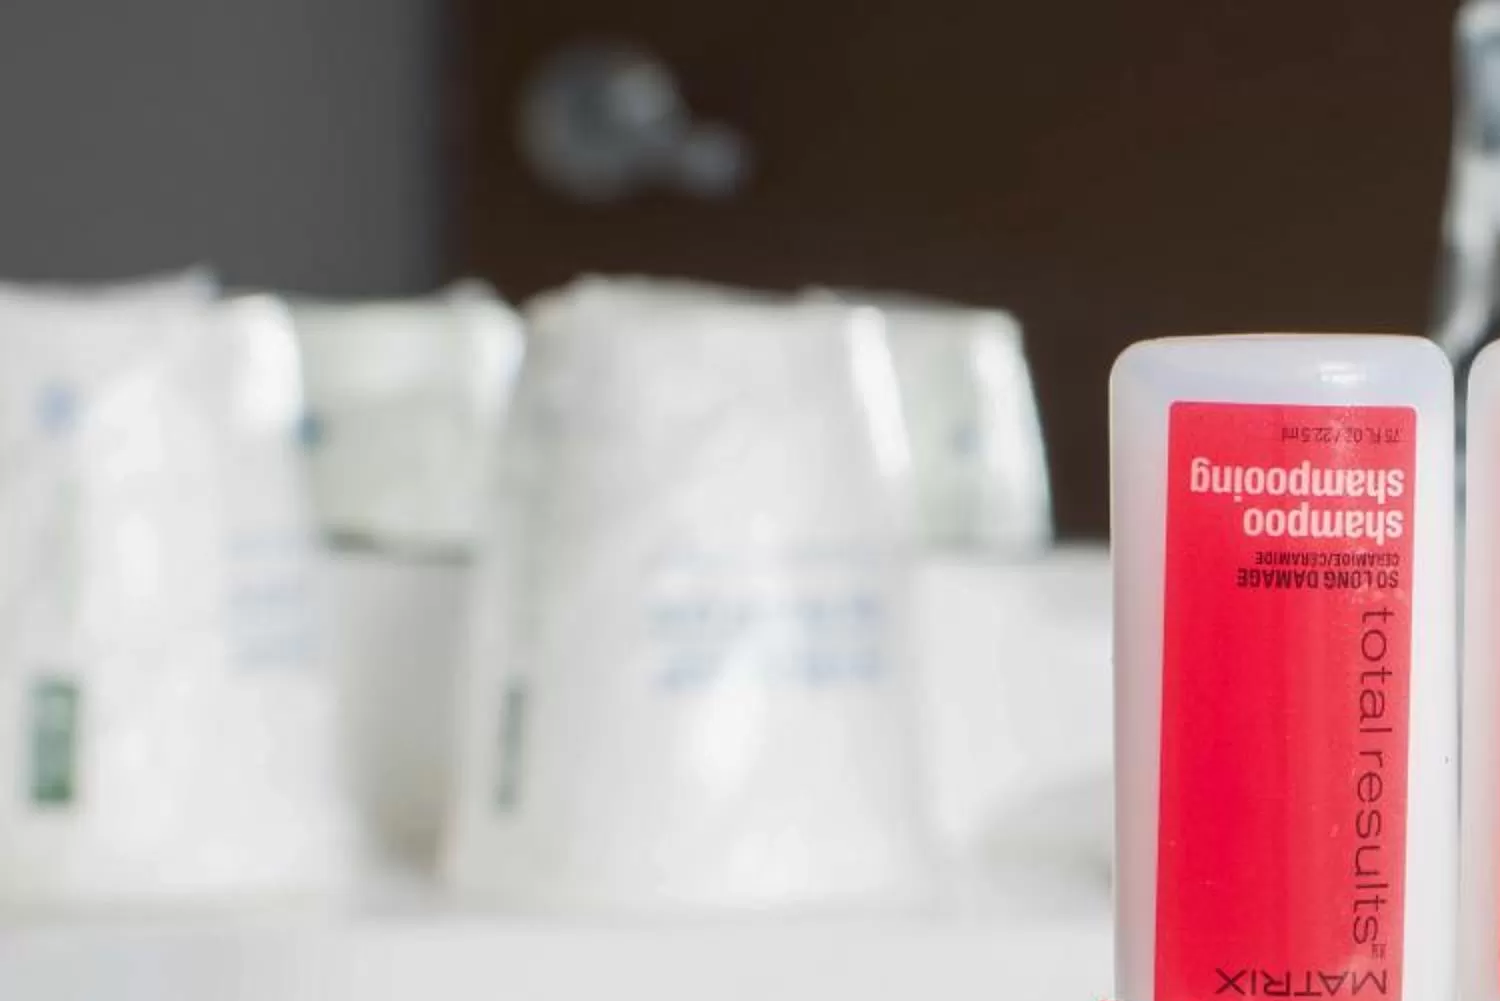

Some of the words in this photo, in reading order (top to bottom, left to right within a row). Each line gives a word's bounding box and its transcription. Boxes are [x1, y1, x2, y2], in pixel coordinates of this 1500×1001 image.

[1282, 428, 1299, 443] ml
[1190, 457, 1405, 504] shampooing
[1243, 501, 1404, 546] shampoo
[1237, 567, 1318, 588] DAMAGE
[1324, 568, 1372, 588] LONG
[1379, 569, 1399, 588] SO
[1359, 607, 1395, 733] total
[1353, 750, 1393, 945] results
[1215, 967, 1388, 997] MATRIX
